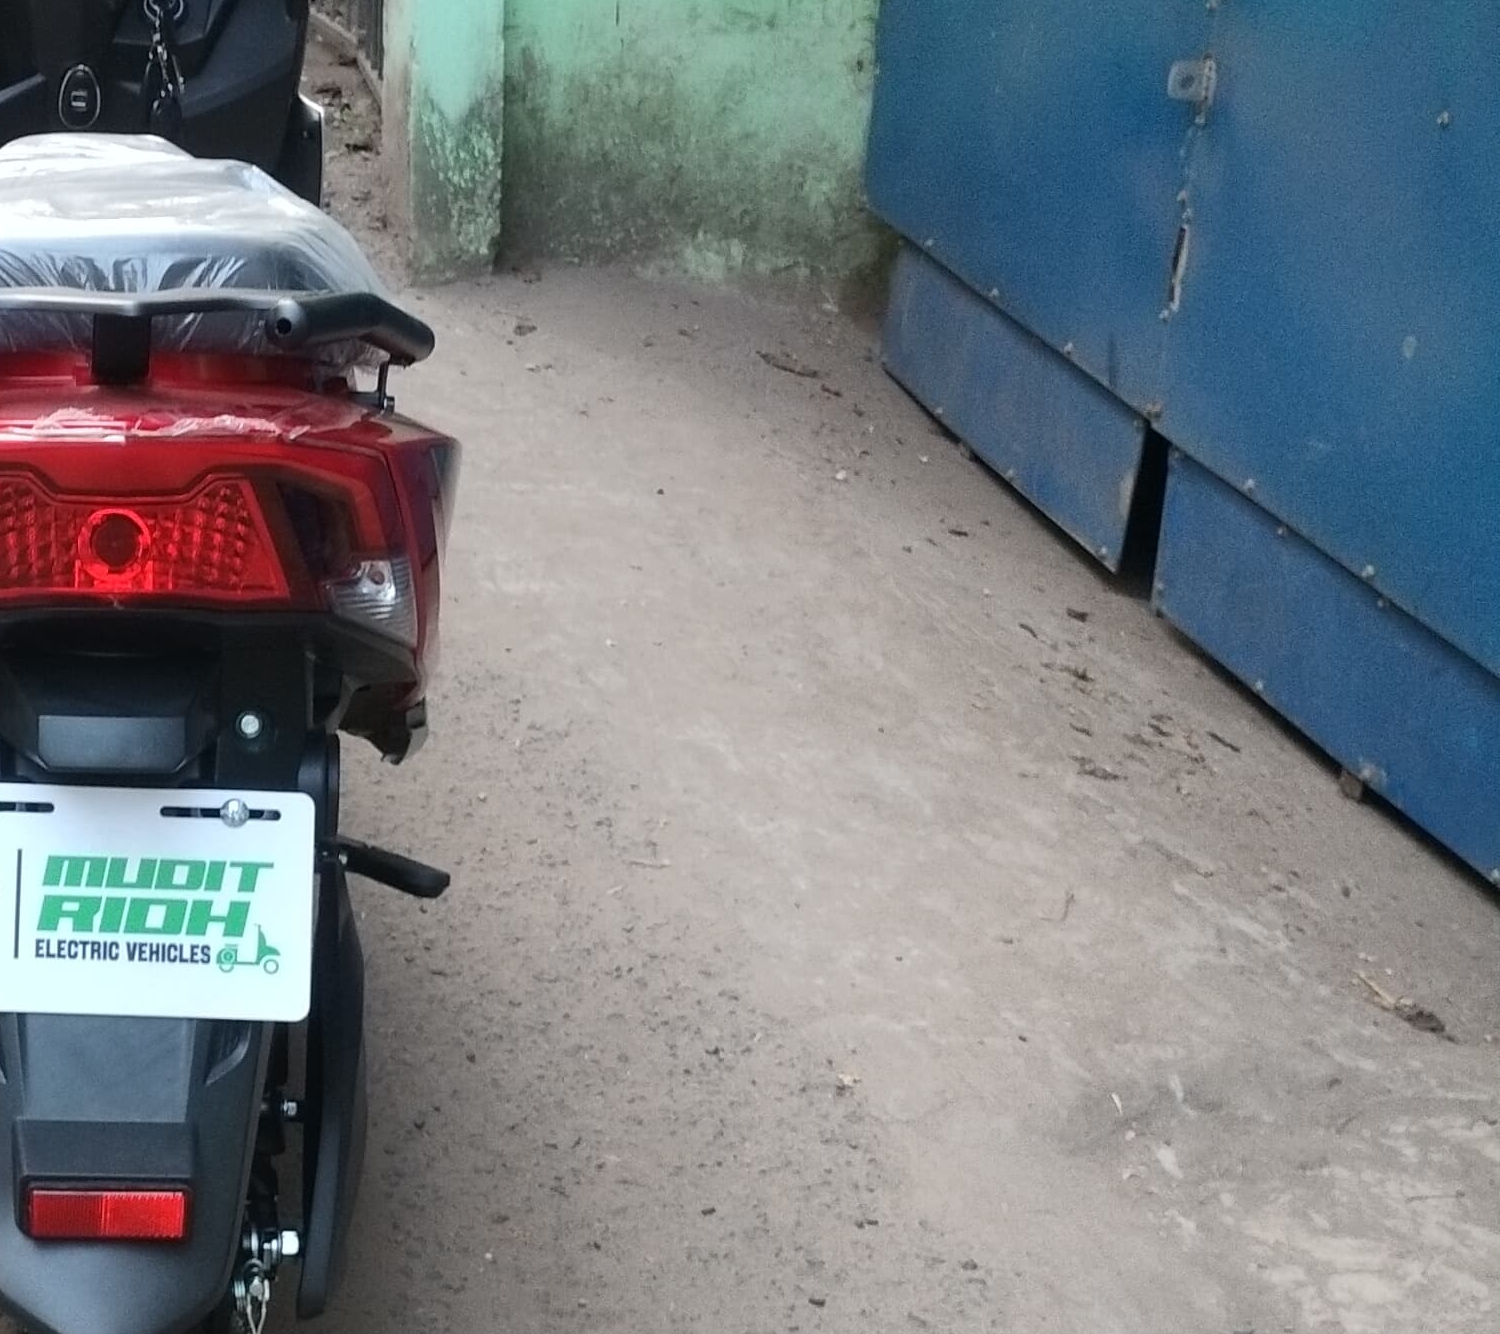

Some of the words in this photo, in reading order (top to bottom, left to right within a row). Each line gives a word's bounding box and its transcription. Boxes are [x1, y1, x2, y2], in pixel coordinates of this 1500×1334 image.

[42, 855, 275, 893] MUDIT
[34, 938, 120, 961] ELECTRIC
[126, 941, 212, 965] VEHICLES
